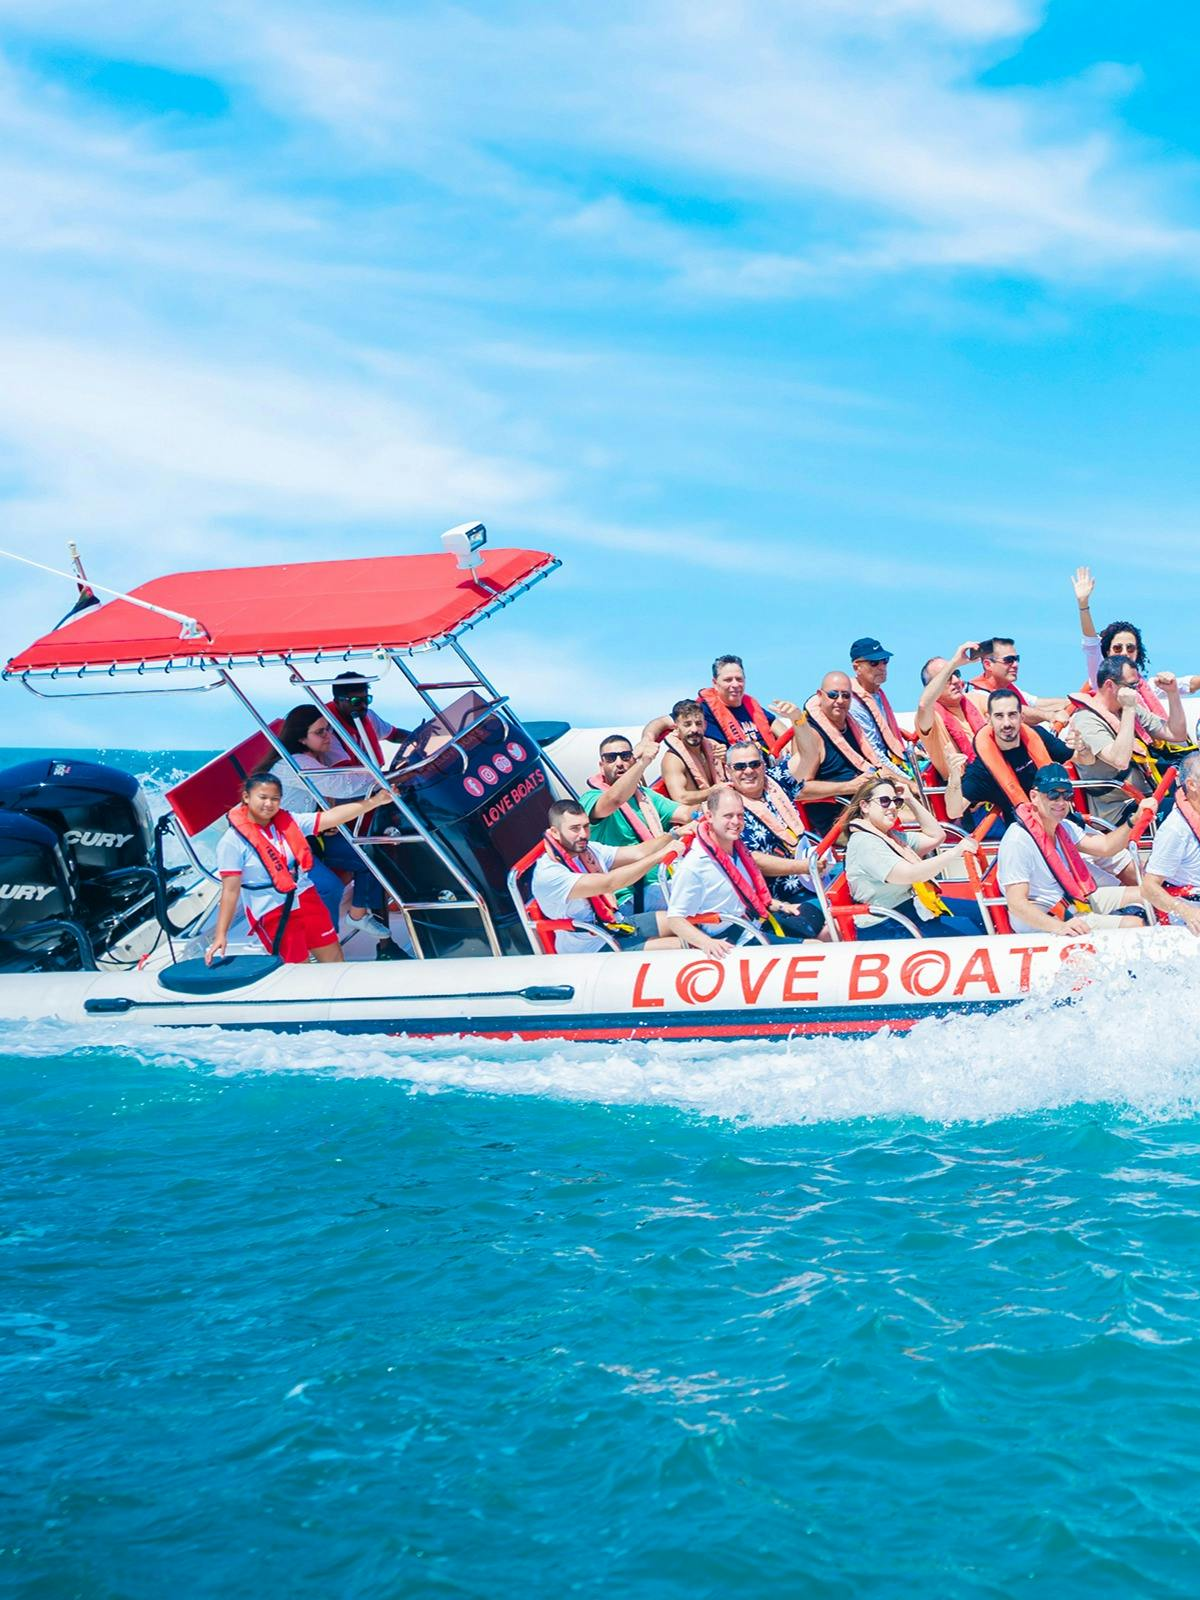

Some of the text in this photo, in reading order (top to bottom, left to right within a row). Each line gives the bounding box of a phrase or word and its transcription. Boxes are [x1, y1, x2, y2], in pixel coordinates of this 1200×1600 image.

[482, 768, 545, 827] LOVE BOATS
[632, 955, 826, 1008] LOVE
